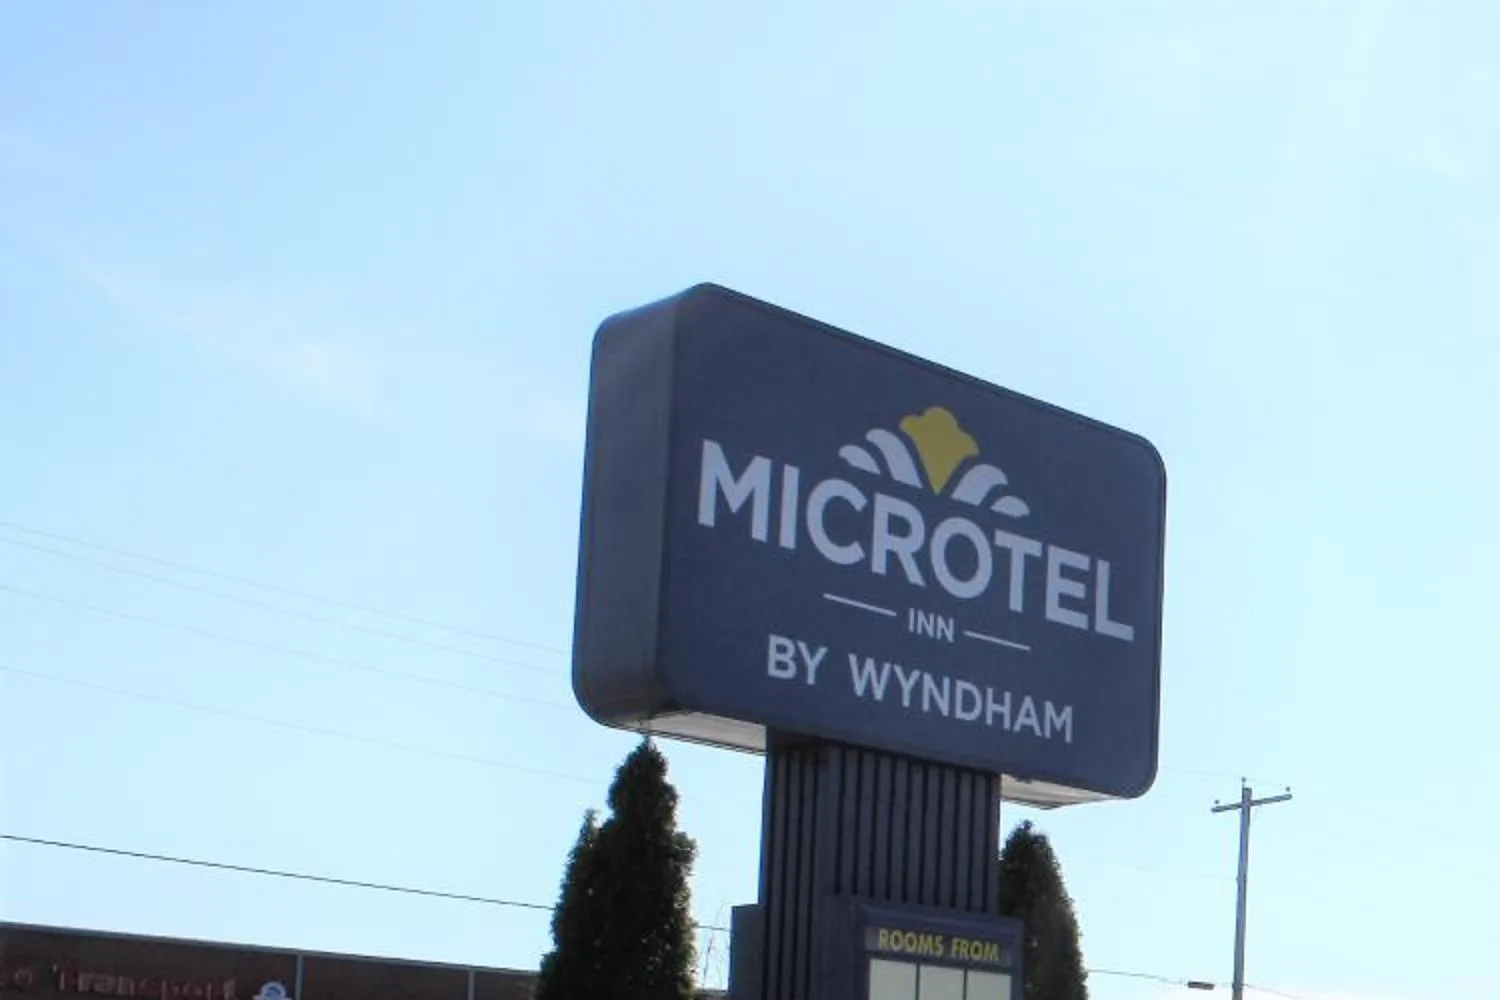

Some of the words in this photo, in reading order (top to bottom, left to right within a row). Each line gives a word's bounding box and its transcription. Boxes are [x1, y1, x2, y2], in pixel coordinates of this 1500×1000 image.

[697, 438, 1135, 642] MICROTEL
[908, 608, 955, 643] INN
[766, 634, 829, 686] BY
[847, 652, 1074, 744] WYNDHAM
[878, 928, 944, 957] ROOMS
[950, 937, 1000, 962] FROM
